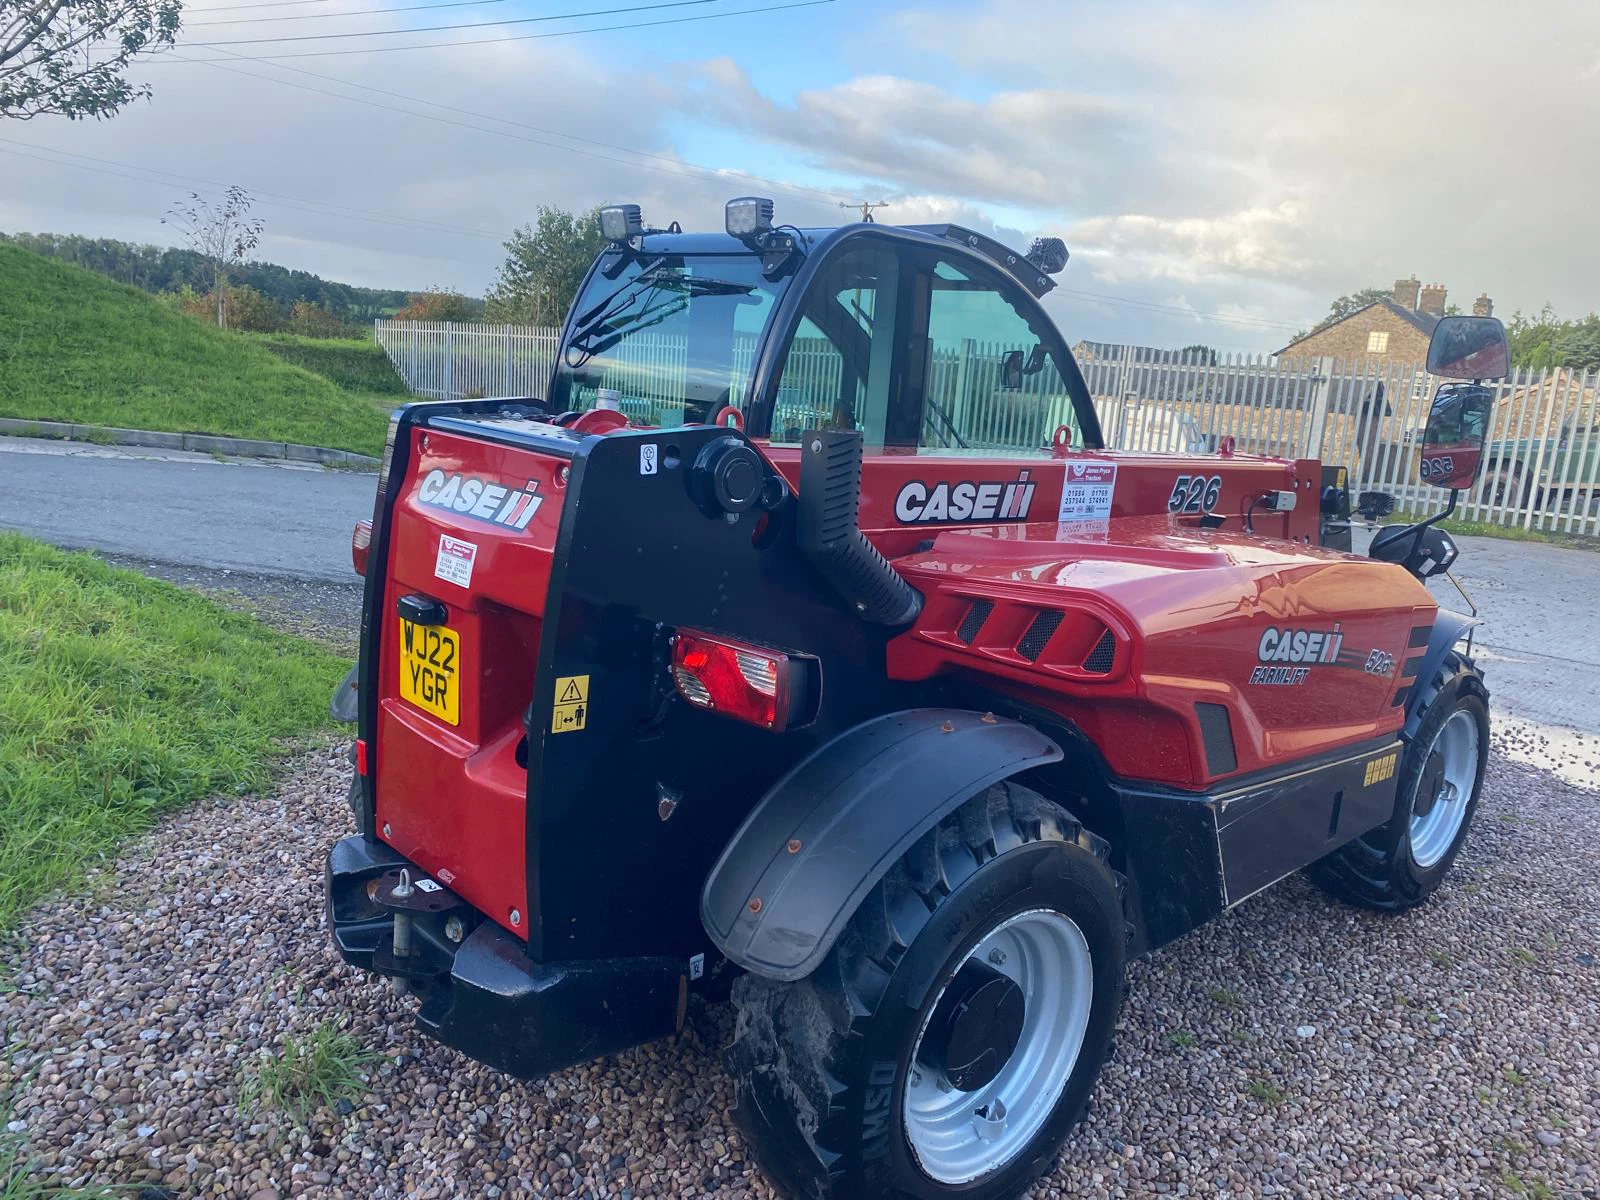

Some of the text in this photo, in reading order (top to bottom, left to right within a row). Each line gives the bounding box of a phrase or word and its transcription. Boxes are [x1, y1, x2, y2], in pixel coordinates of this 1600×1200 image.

[1168, 475, 1222, 514] 526
[404, 619, 455, 674] WJ22
[1365, 648, 1393, 676] 526
[410, 660, 447, 711] YGR
[1248, 666, 1311, 685] FARMLIFT
